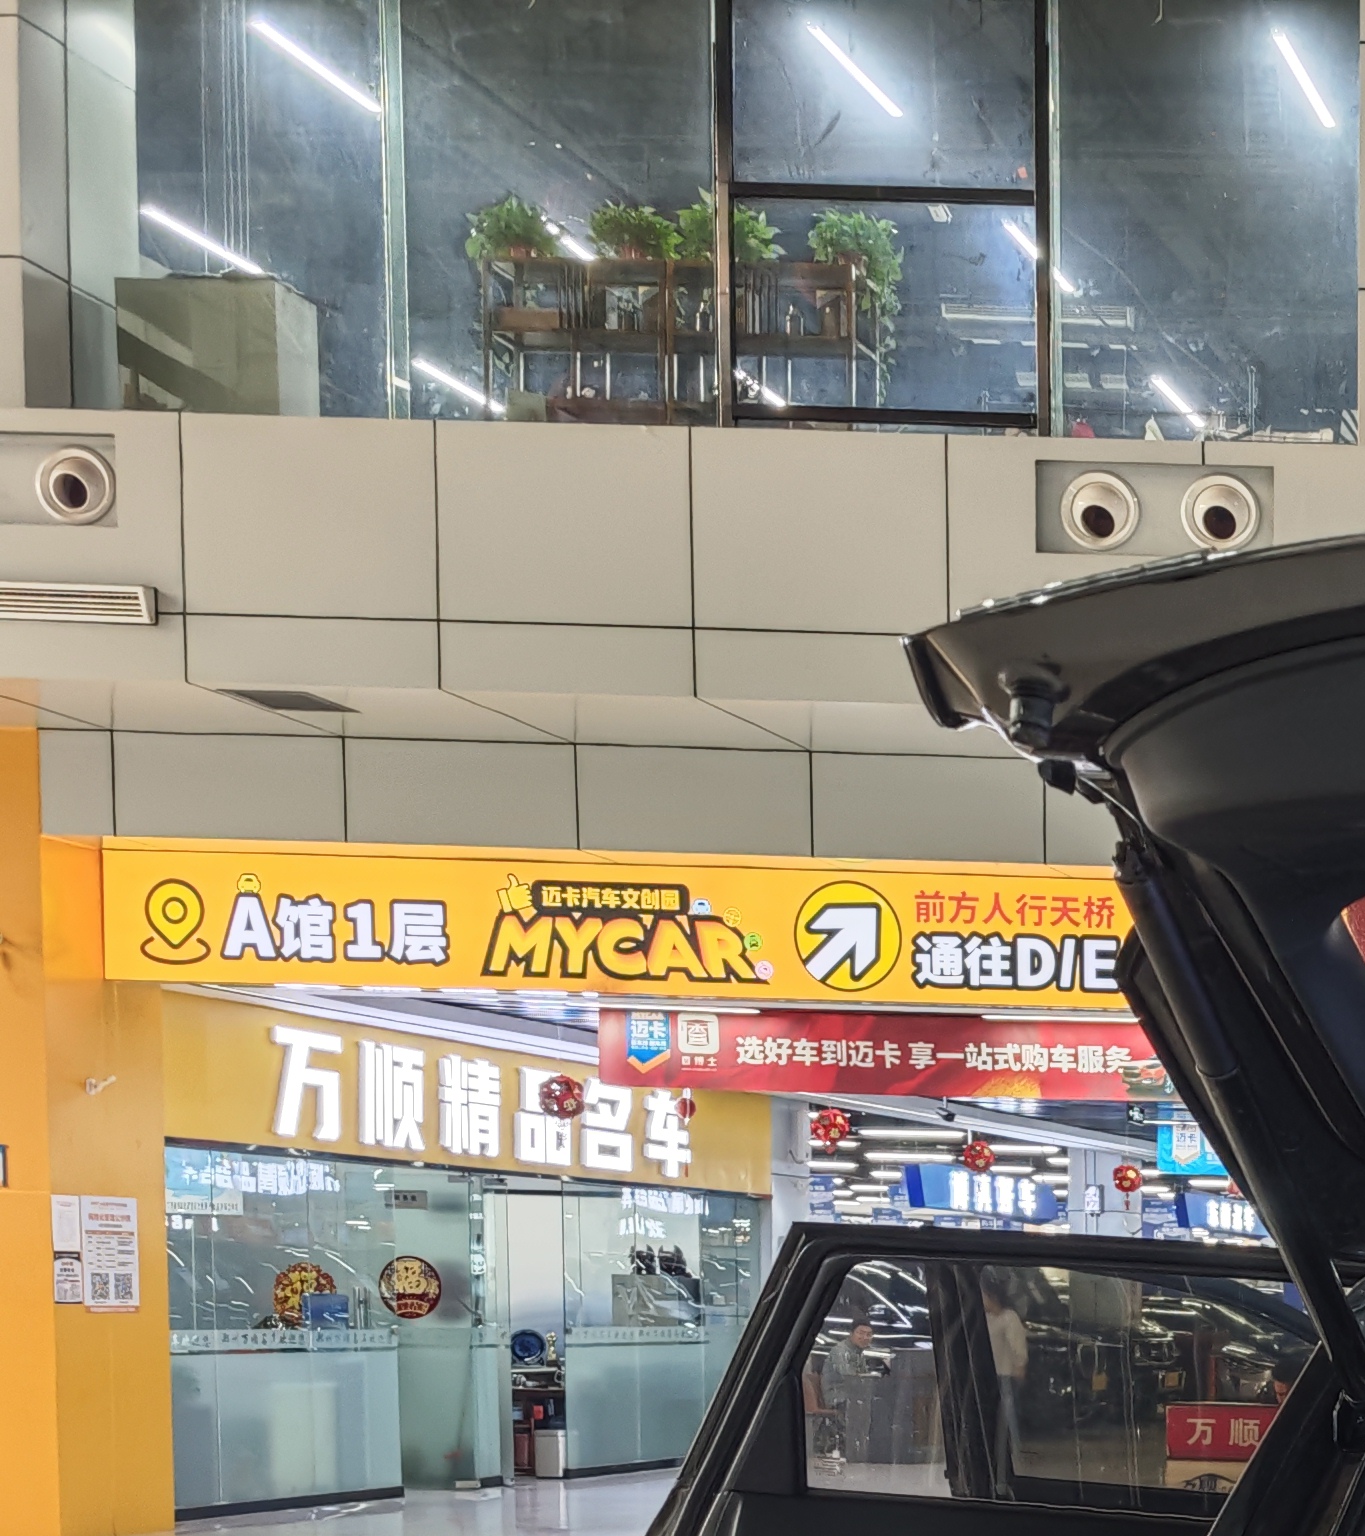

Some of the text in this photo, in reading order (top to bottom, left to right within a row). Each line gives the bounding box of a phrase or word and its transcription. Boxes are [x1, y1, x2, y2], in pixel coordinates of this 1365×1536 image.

[540, 884, 682, 912] 迈卡汽车文创园
[913, 889, 1115, 930] 前方人行天桥
[222, 894, 452, 965] A馆1层
[490, 914, 758, 981] MYCAR
[914, 934, 1121, 990] 通往D/E
[735, 1034, 1134, 1076] 选好车到迈卡 享一站式购车服务
[271, 1024, 692, 1178] 万顺精品名车
[1186, 1417, 1261, 1448] 万顺
